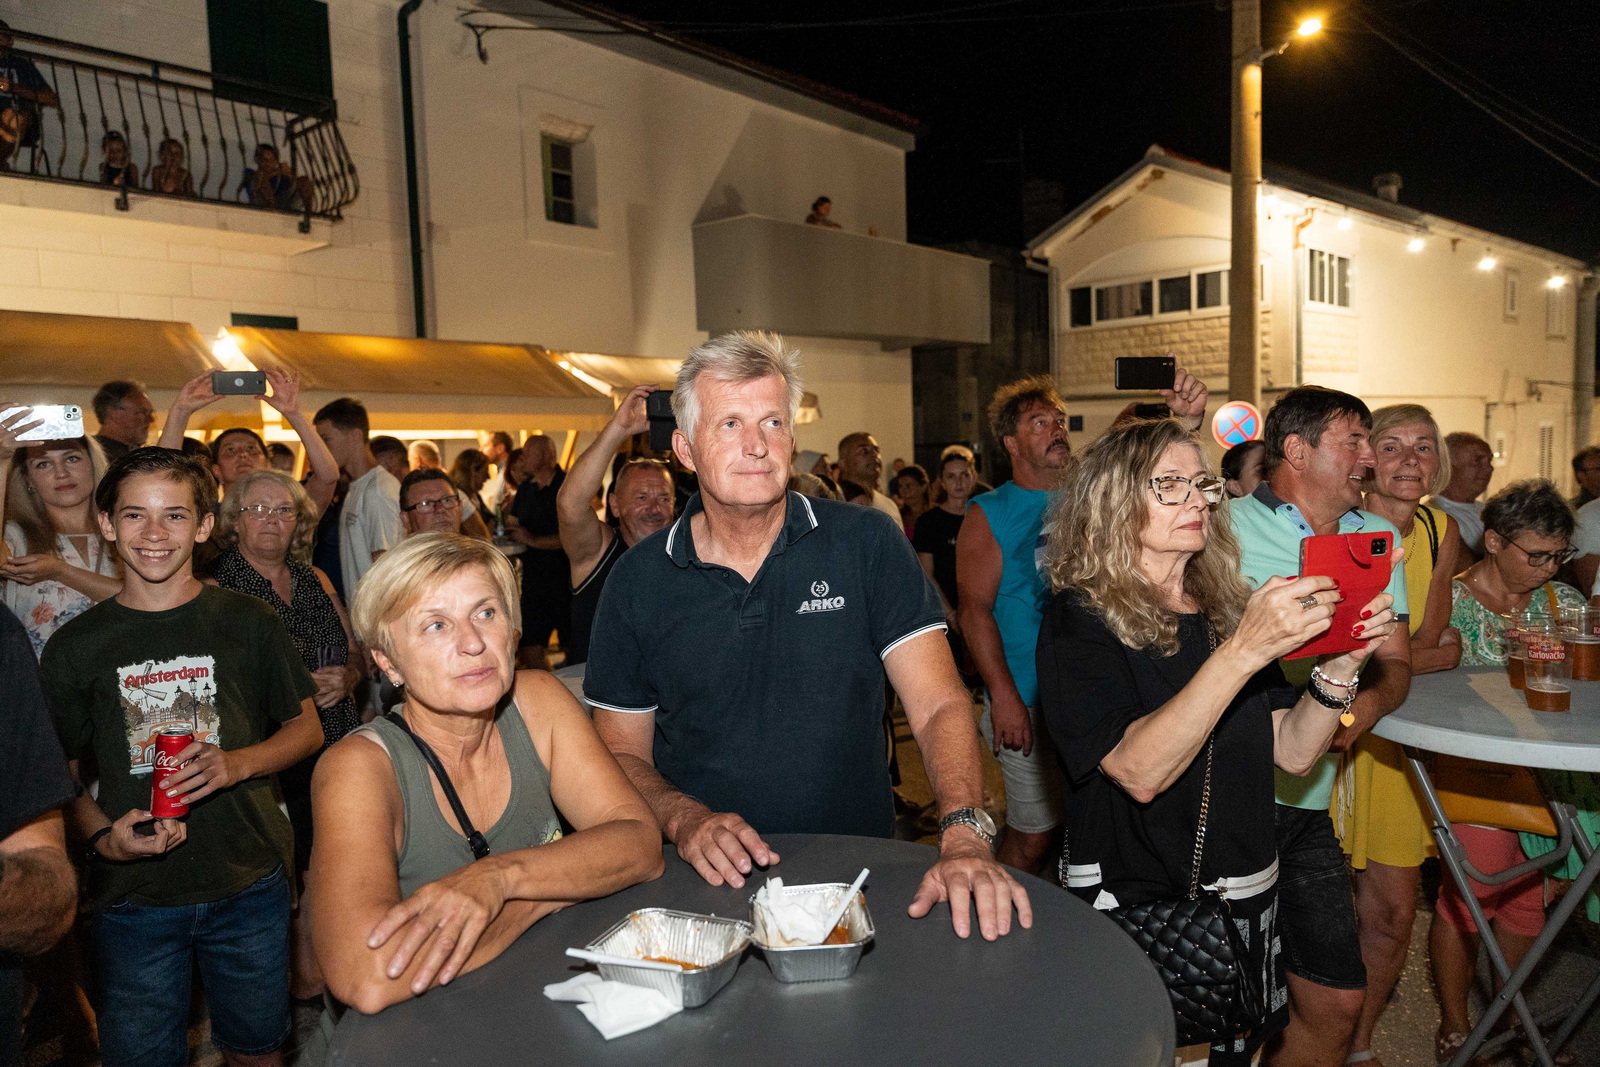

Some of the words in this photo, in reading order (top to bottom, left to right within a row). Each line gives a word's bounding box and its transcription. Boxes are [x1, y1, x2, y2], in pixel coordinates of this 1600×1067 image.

[799, 596, 845, 612] ARKO
[1528, 649, 1566, 660] Karlovačko
[125, 666, 209, 689] Amsterdam
